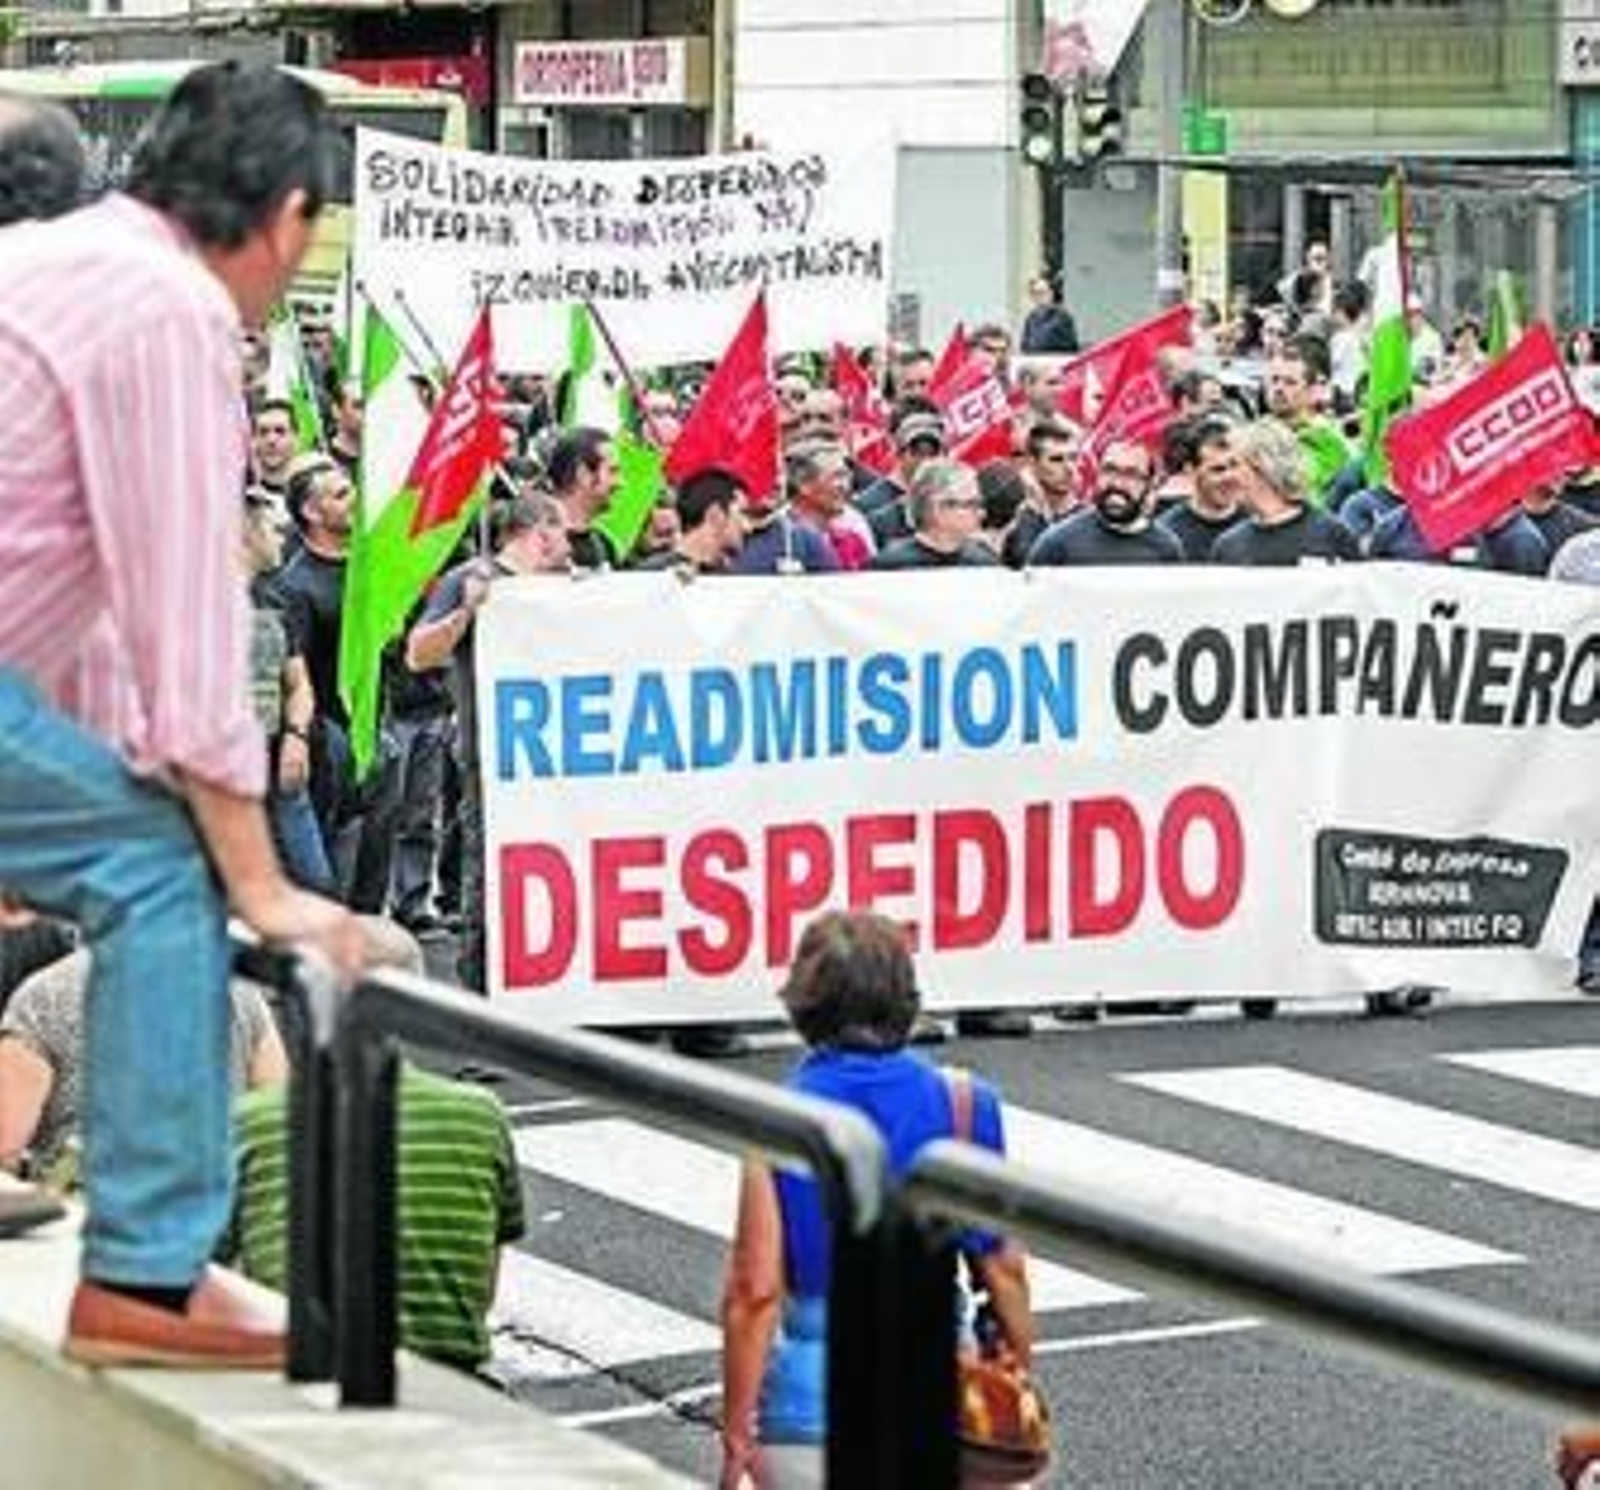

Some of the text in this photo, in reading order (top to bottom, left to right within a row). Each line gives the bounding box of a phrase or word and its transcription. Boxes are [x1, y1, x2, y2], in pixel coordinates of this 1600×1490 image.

[1454, 377, 1562, 457] CCOO
[495, 640, 1080, 780] READMISION
[498, 785, 1246, 991] DESPEDIDO
